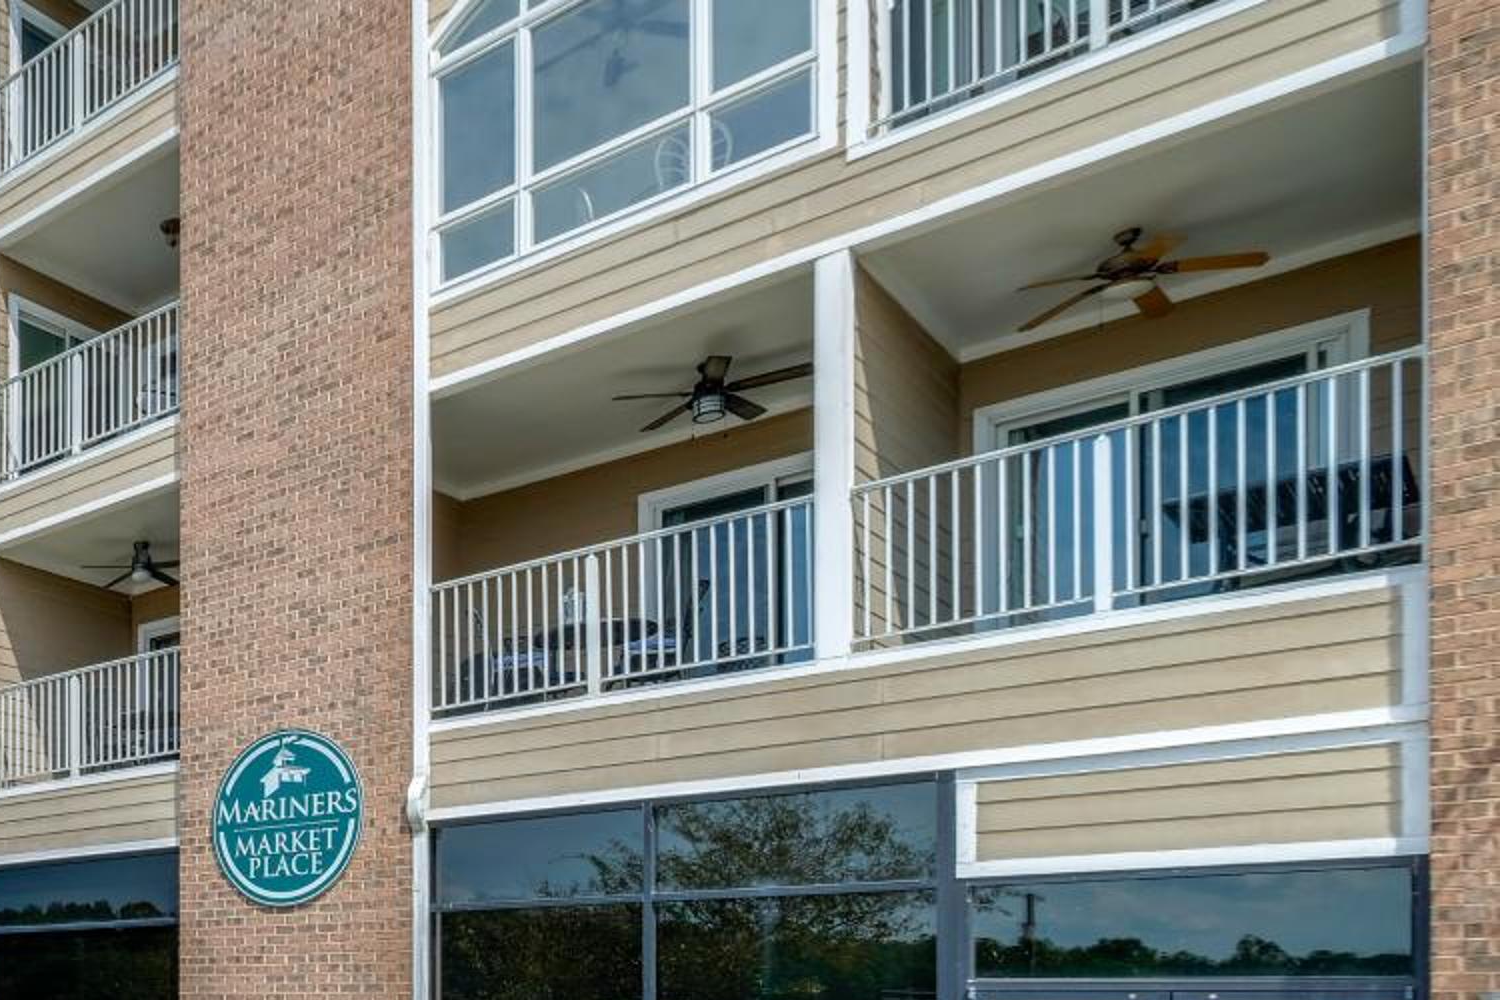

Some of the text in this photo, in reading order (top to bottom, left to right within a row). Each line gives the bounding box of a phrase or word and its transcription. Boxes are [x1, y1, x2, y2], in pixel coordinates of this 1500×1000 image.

[217, 787, 358, 825] MARINERS
[235, 827, 339, 858] MARKET
[249, 851, 323, 879] PLACE
